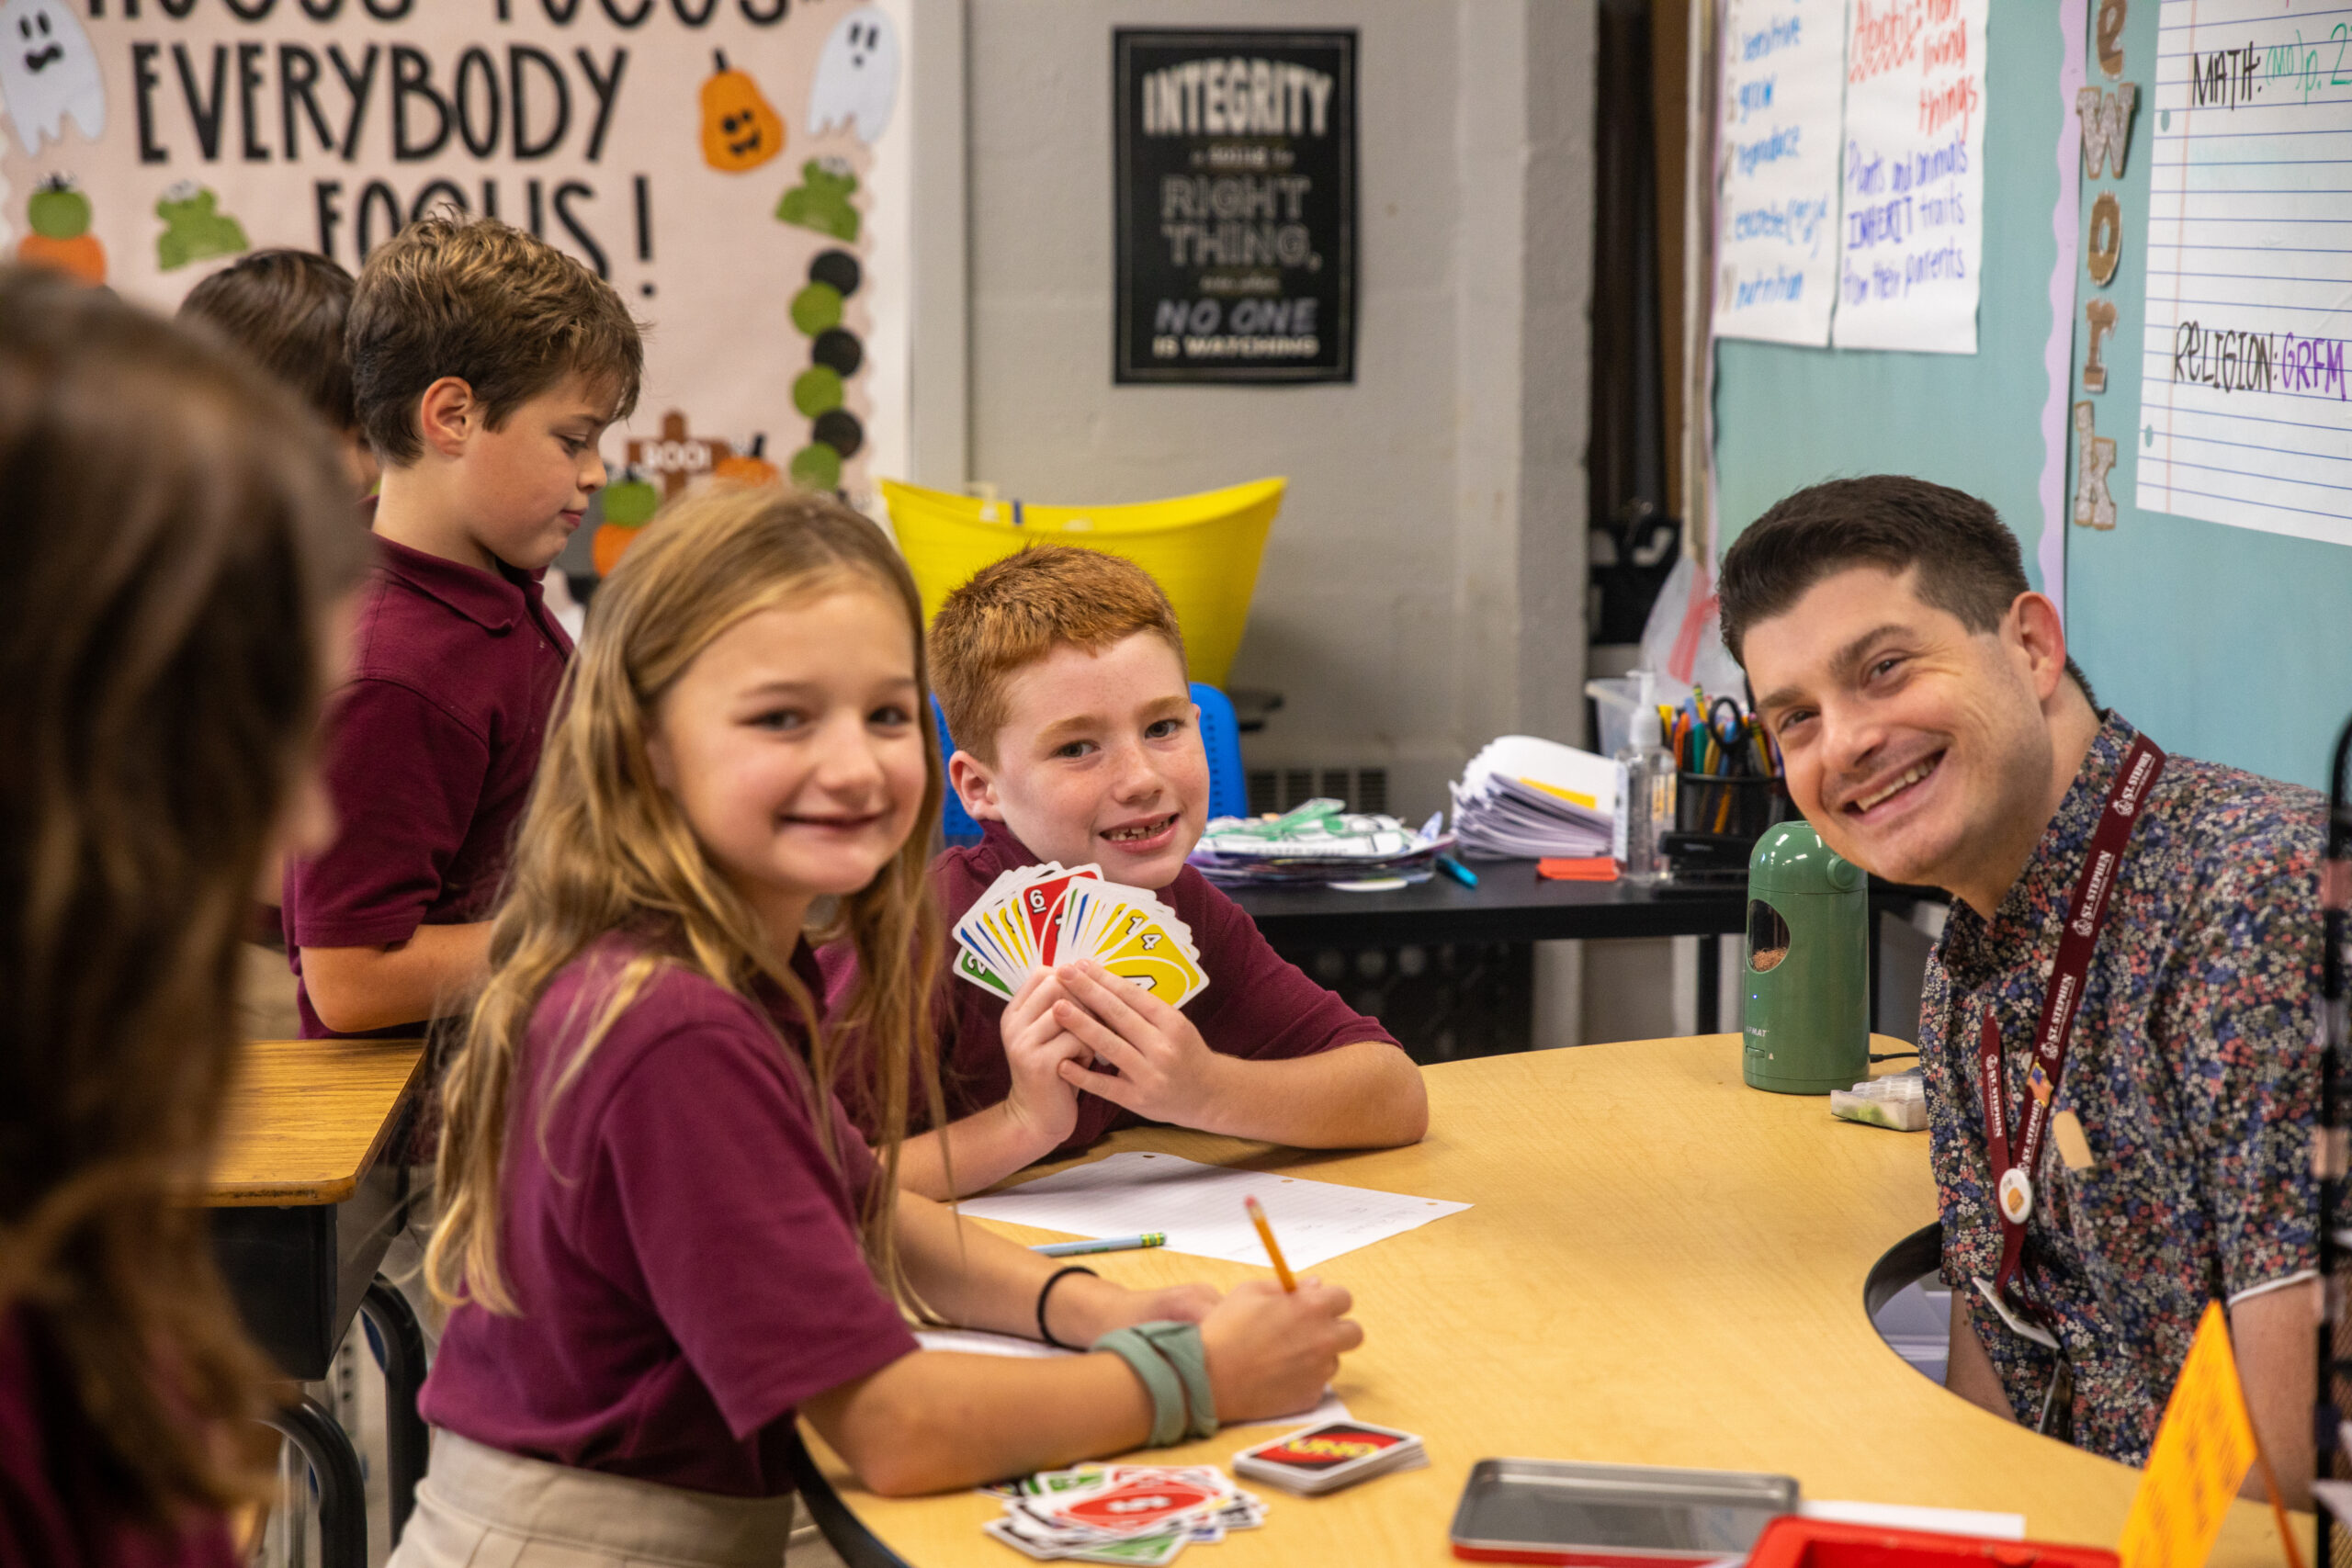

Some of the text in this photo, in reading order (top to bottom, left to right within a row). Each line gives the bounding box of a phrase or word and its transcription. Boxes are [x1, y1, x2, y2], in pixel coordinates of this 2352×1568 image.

[1142, 56, 1334, 137] INTEGRITY
[2192, 40, 2262, 111] MATH:
[131, 42, 628, 164] EVERYBODY
[1917, 73, 1978, 143] things
[1159, 174, 1311, 221] RIGHT
[1905, 237, 1965, 299] parents
[1154, 297, 1320, 335] NO ONE
[1152, 335, 1181, 358] IS
[1028, 887, 1046, 913] 6
[1125, 915, 1145, 935] 1
[1141, 932, 1163, 951] 4
